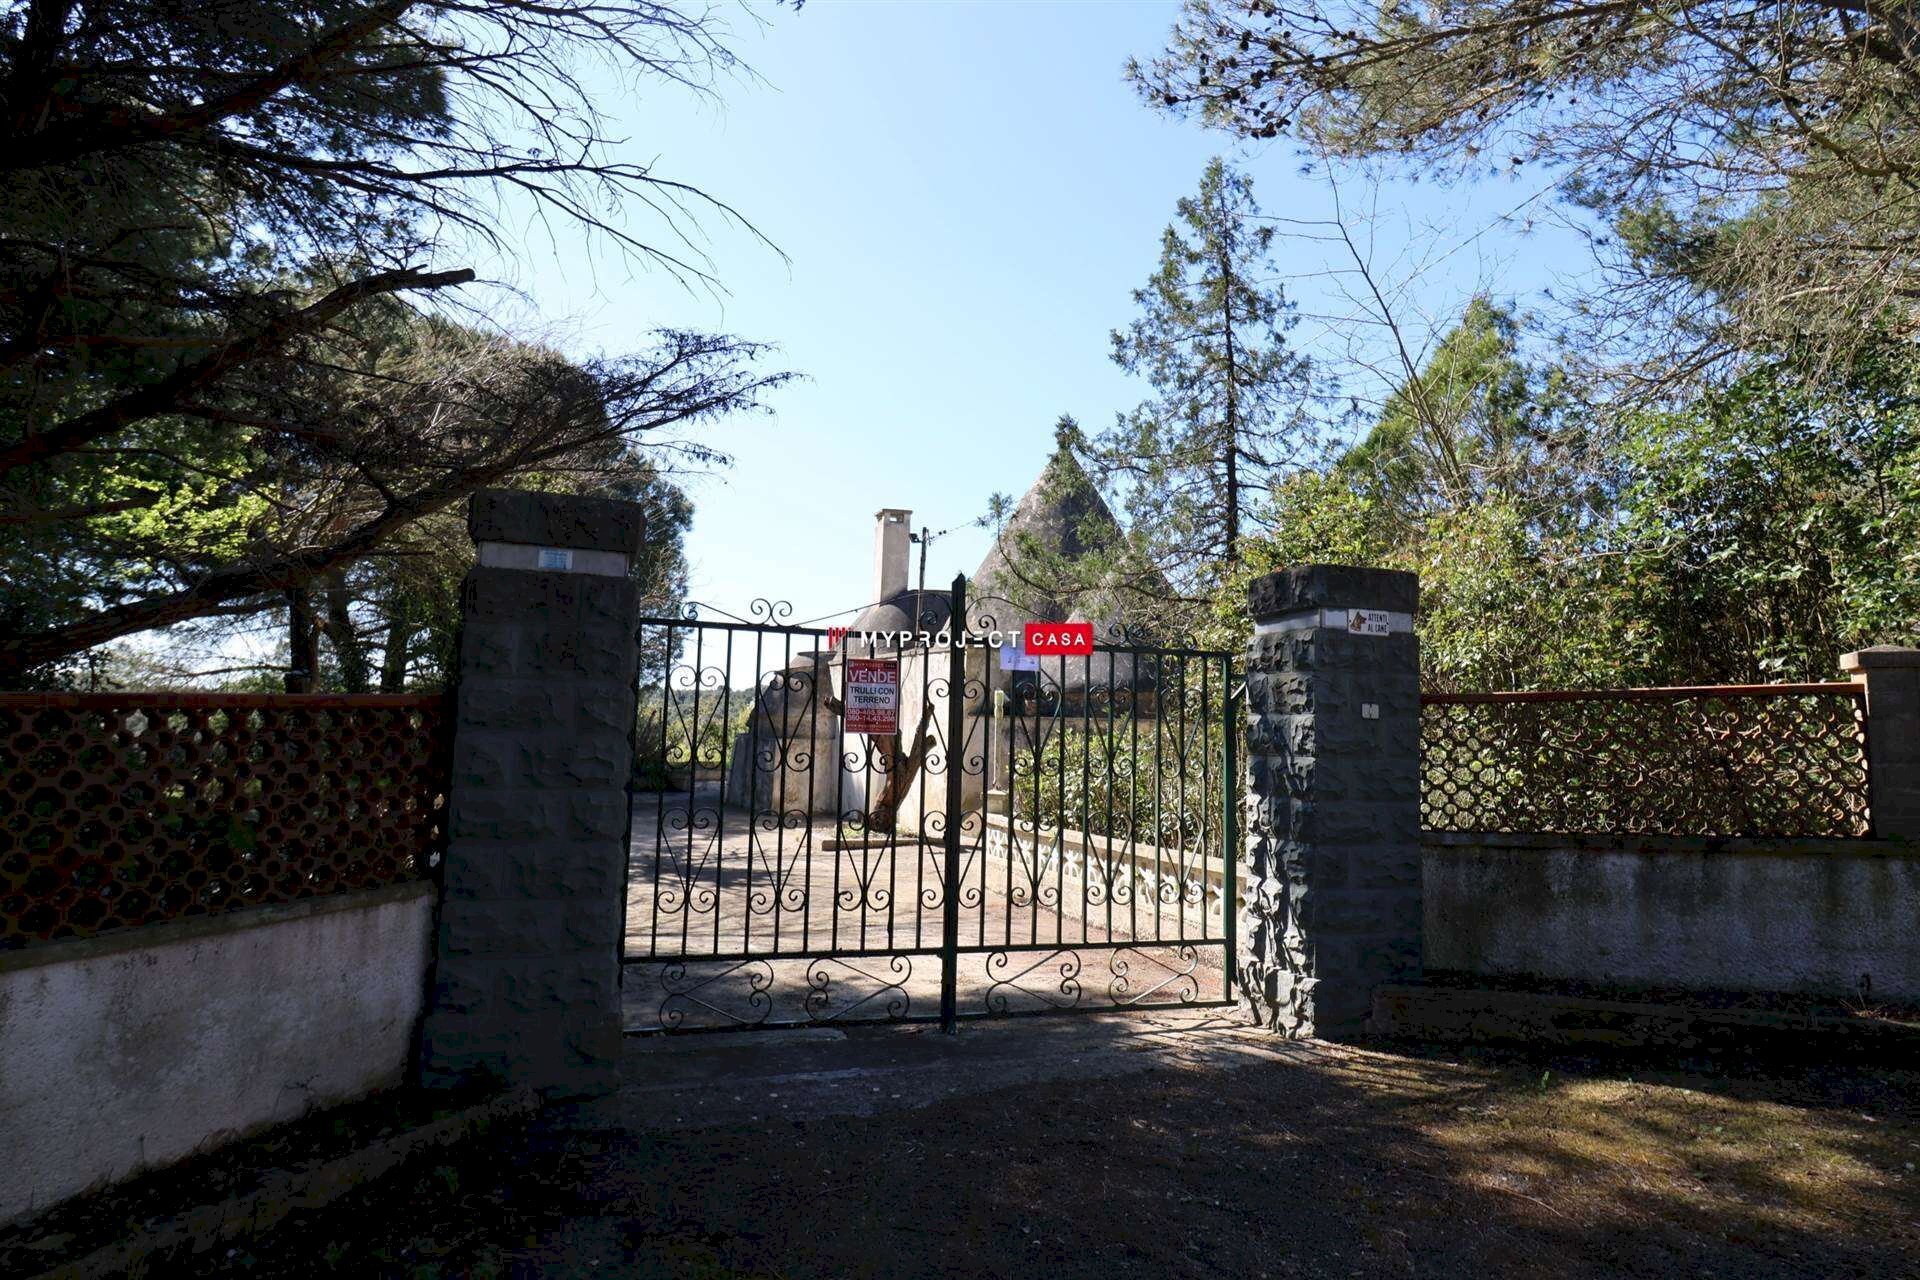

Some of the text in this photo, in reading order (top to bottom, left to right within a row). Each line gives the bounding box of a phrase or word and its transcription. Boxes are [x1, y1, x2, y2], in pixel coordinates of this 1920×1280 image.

[849, 670, 896, 683] VENDE
[850, 686, 895, 696] TRULLI CON
[854, 695, 890, 704] TERRENO
